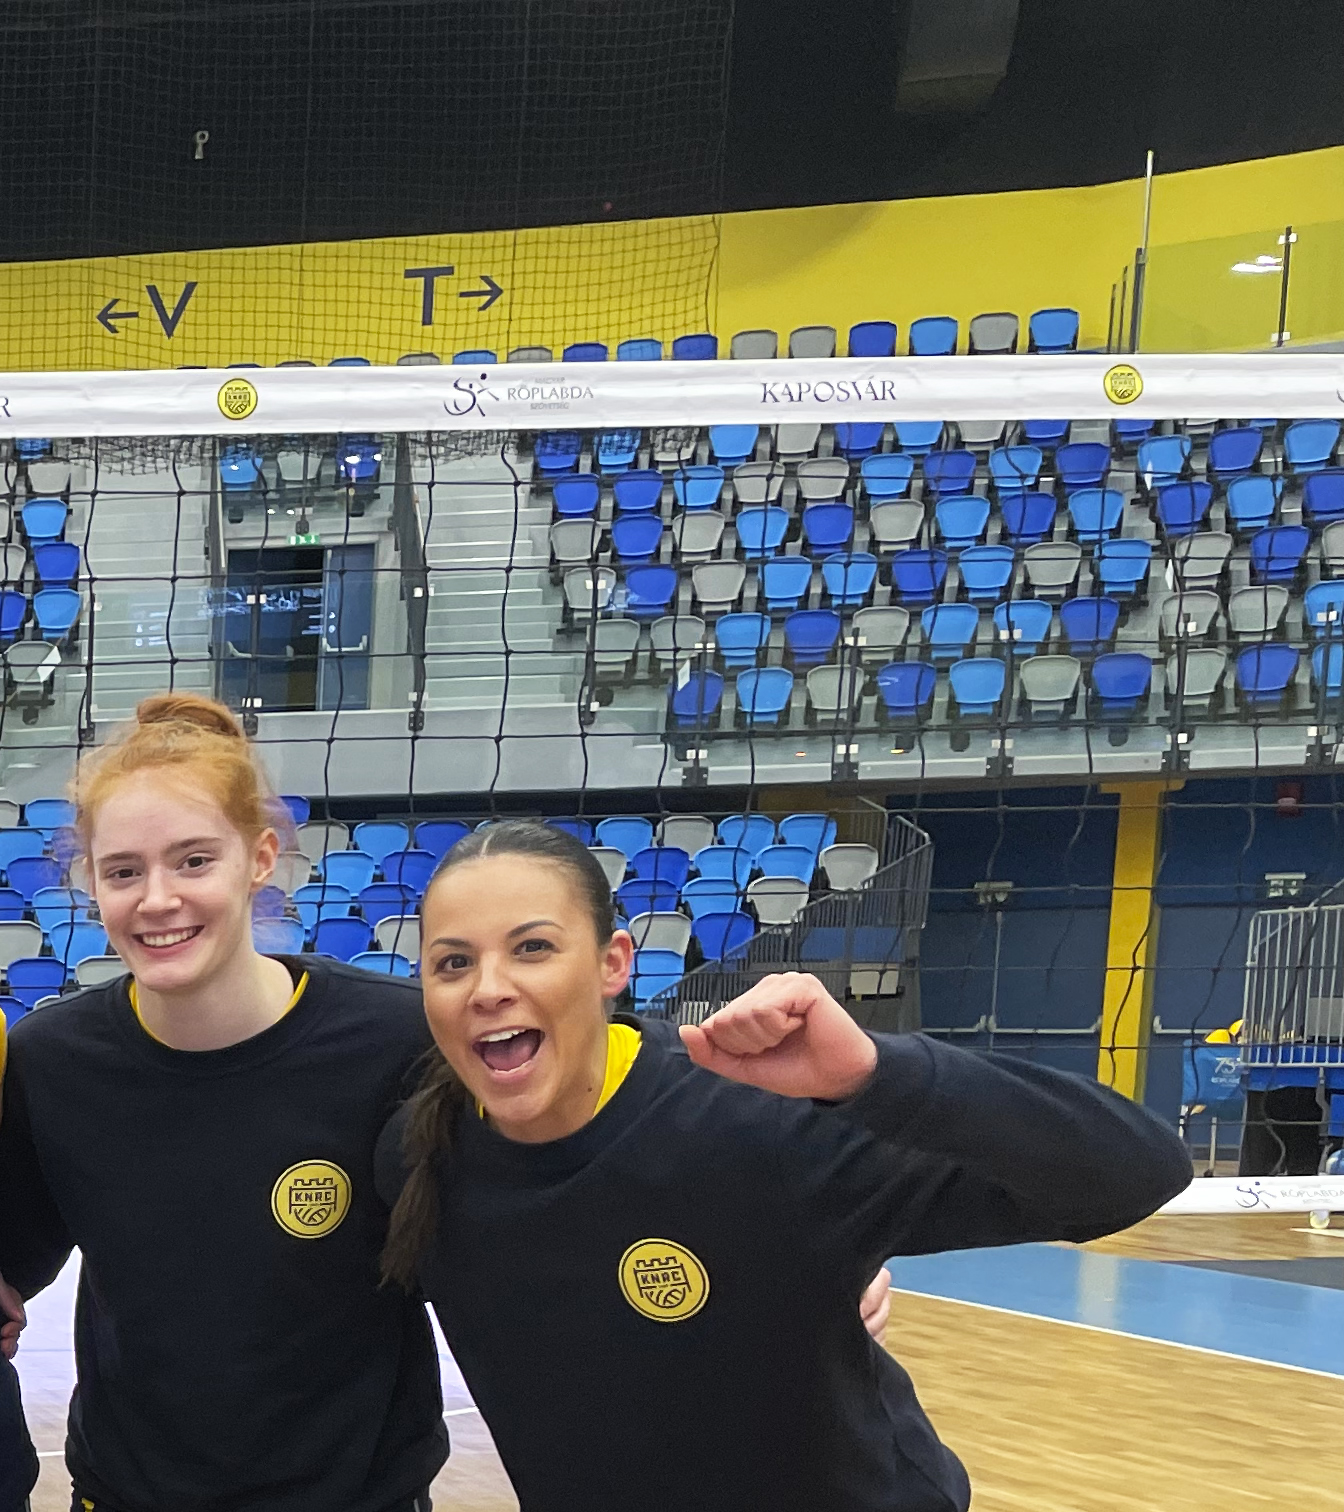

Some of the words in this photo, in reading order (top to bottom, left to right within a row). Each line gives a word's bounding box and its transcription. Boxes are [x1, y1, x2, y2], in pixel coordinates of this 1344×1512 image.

[145, 281, 199, 340] V
[404, 265, 455, 327] T
[760, 375, 897, 404] KAPOSVÁR
[294, 1191, 332, 1203] KNRC
[640, 1271, 682, 1285] KNRC
